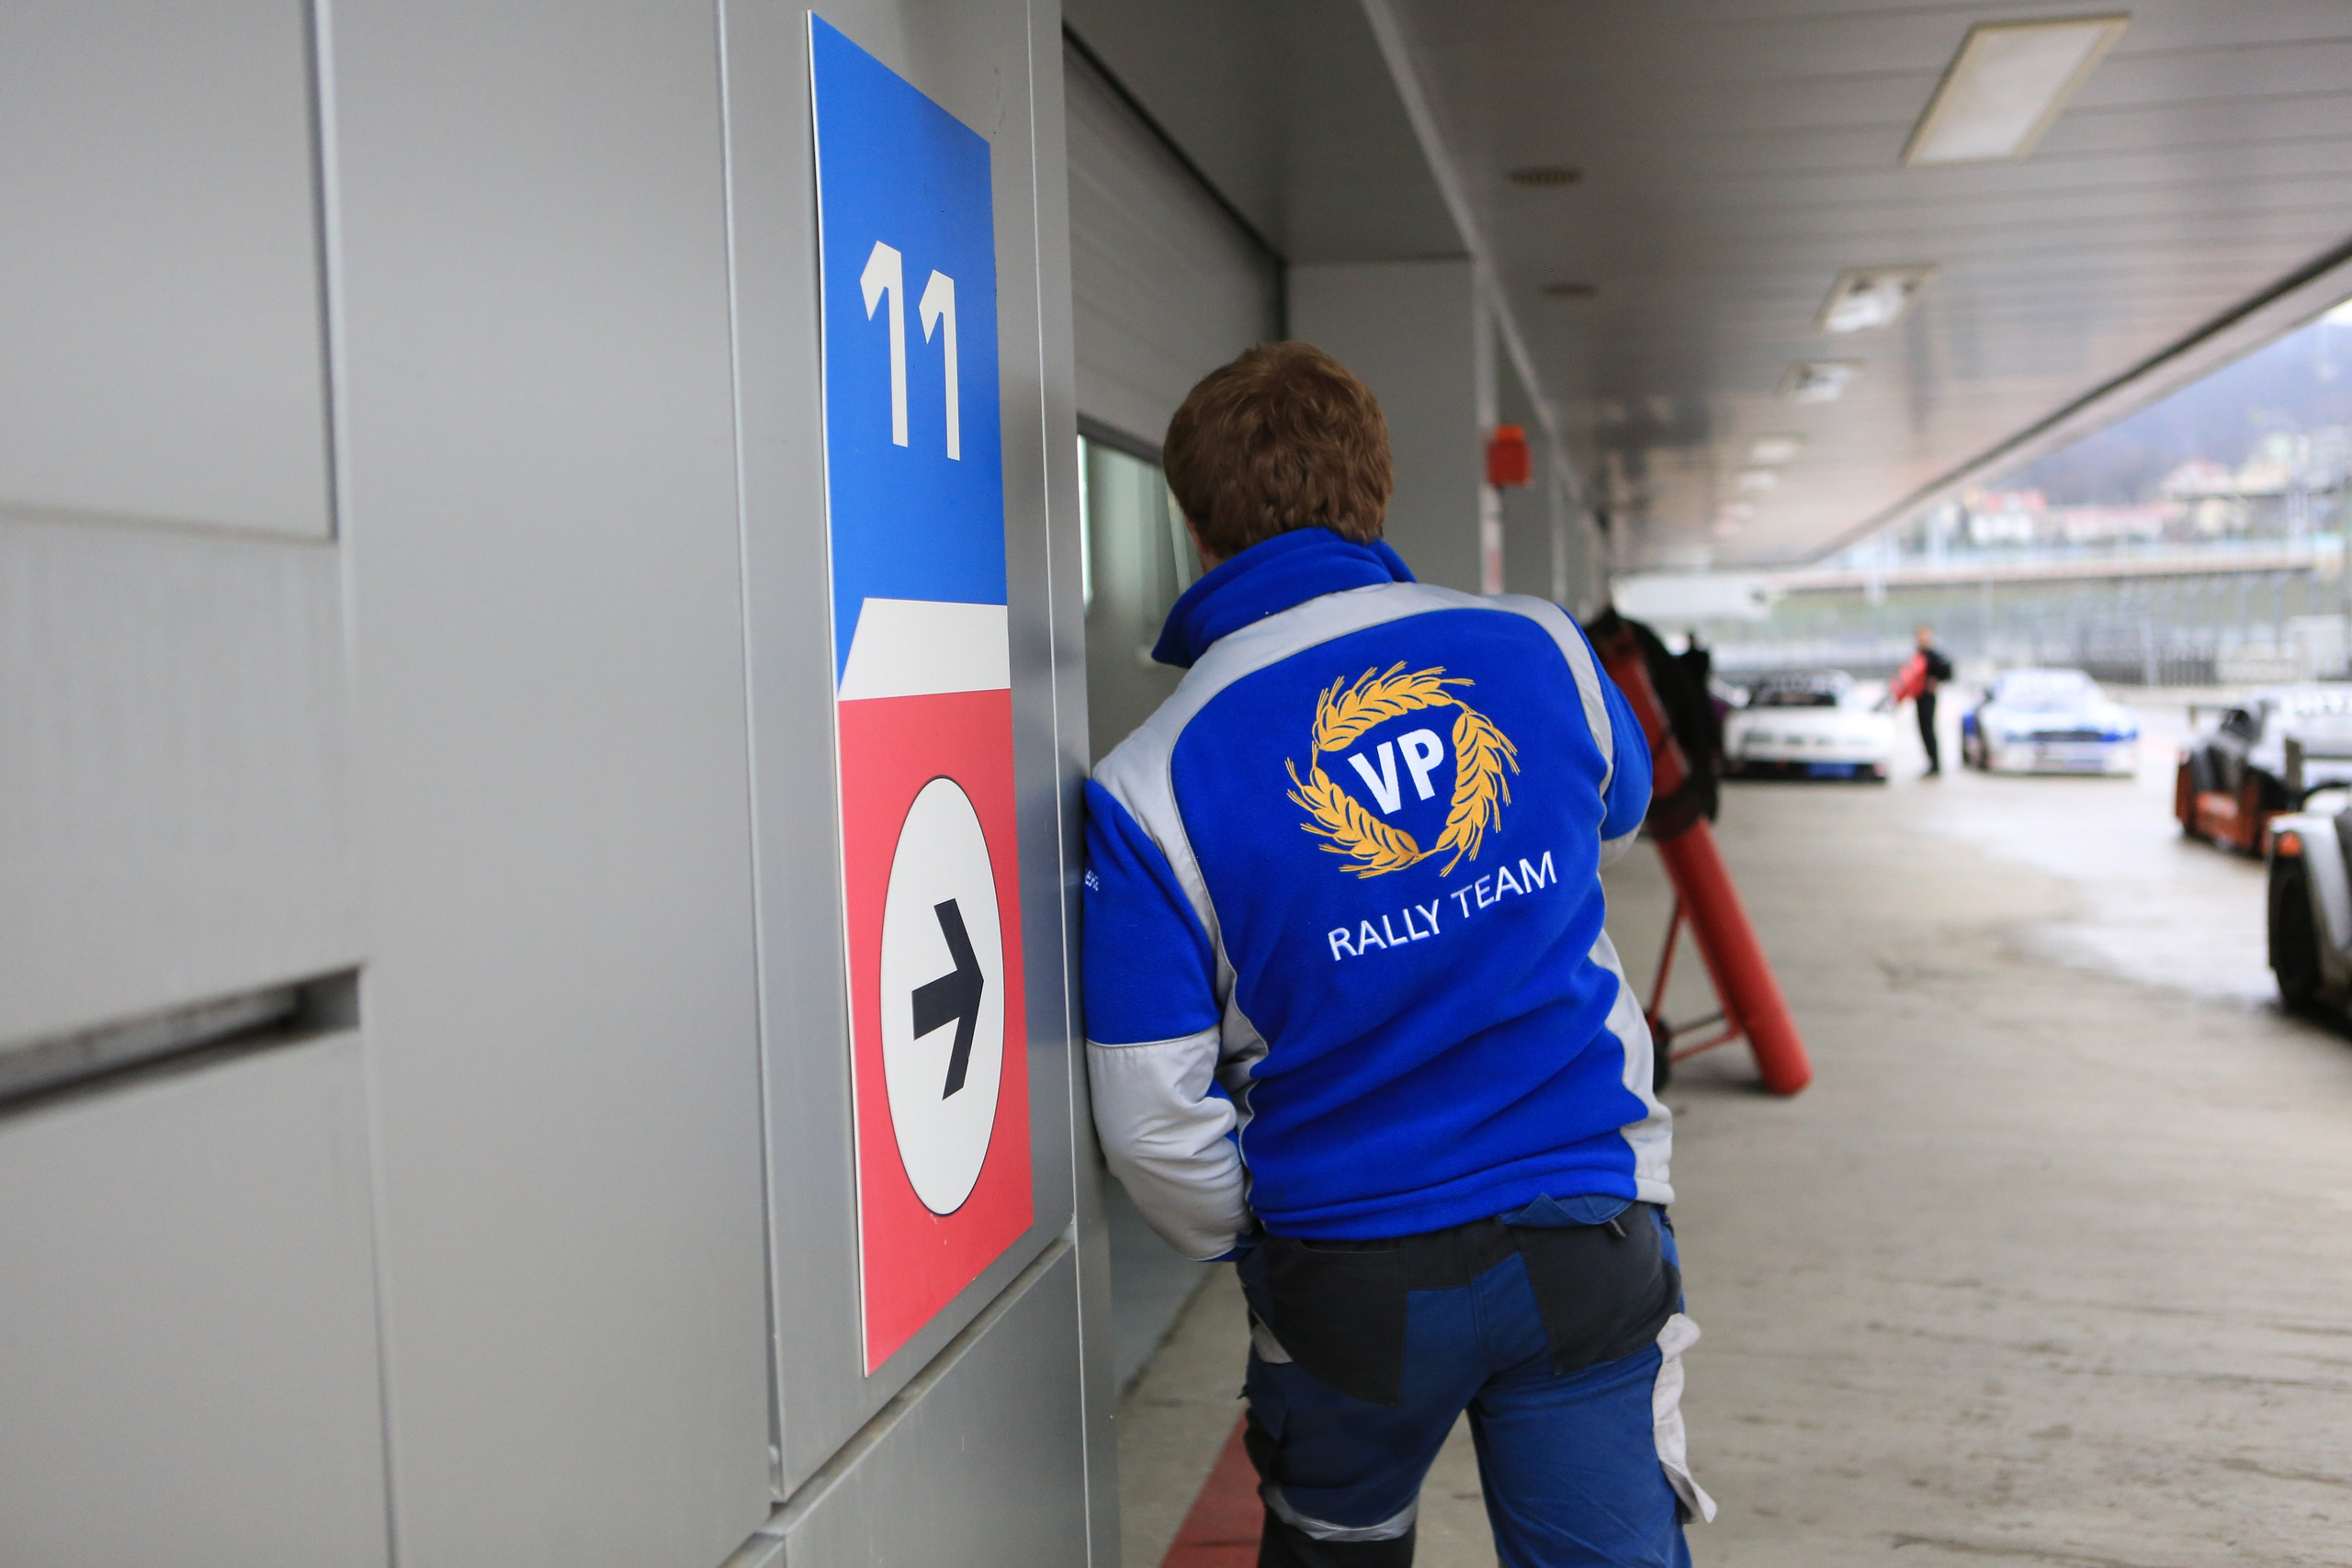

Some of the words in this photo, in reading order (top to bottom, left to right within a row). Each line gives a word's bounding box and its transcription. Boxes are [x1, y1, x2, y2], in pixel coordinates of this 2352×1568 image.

[860, 241, 960, 461] 11
[1348, 729, 1444, 815] VP
[1328, 899, 1441, 961] RALLY
[1451, 851, 1557, 919] TEAM
